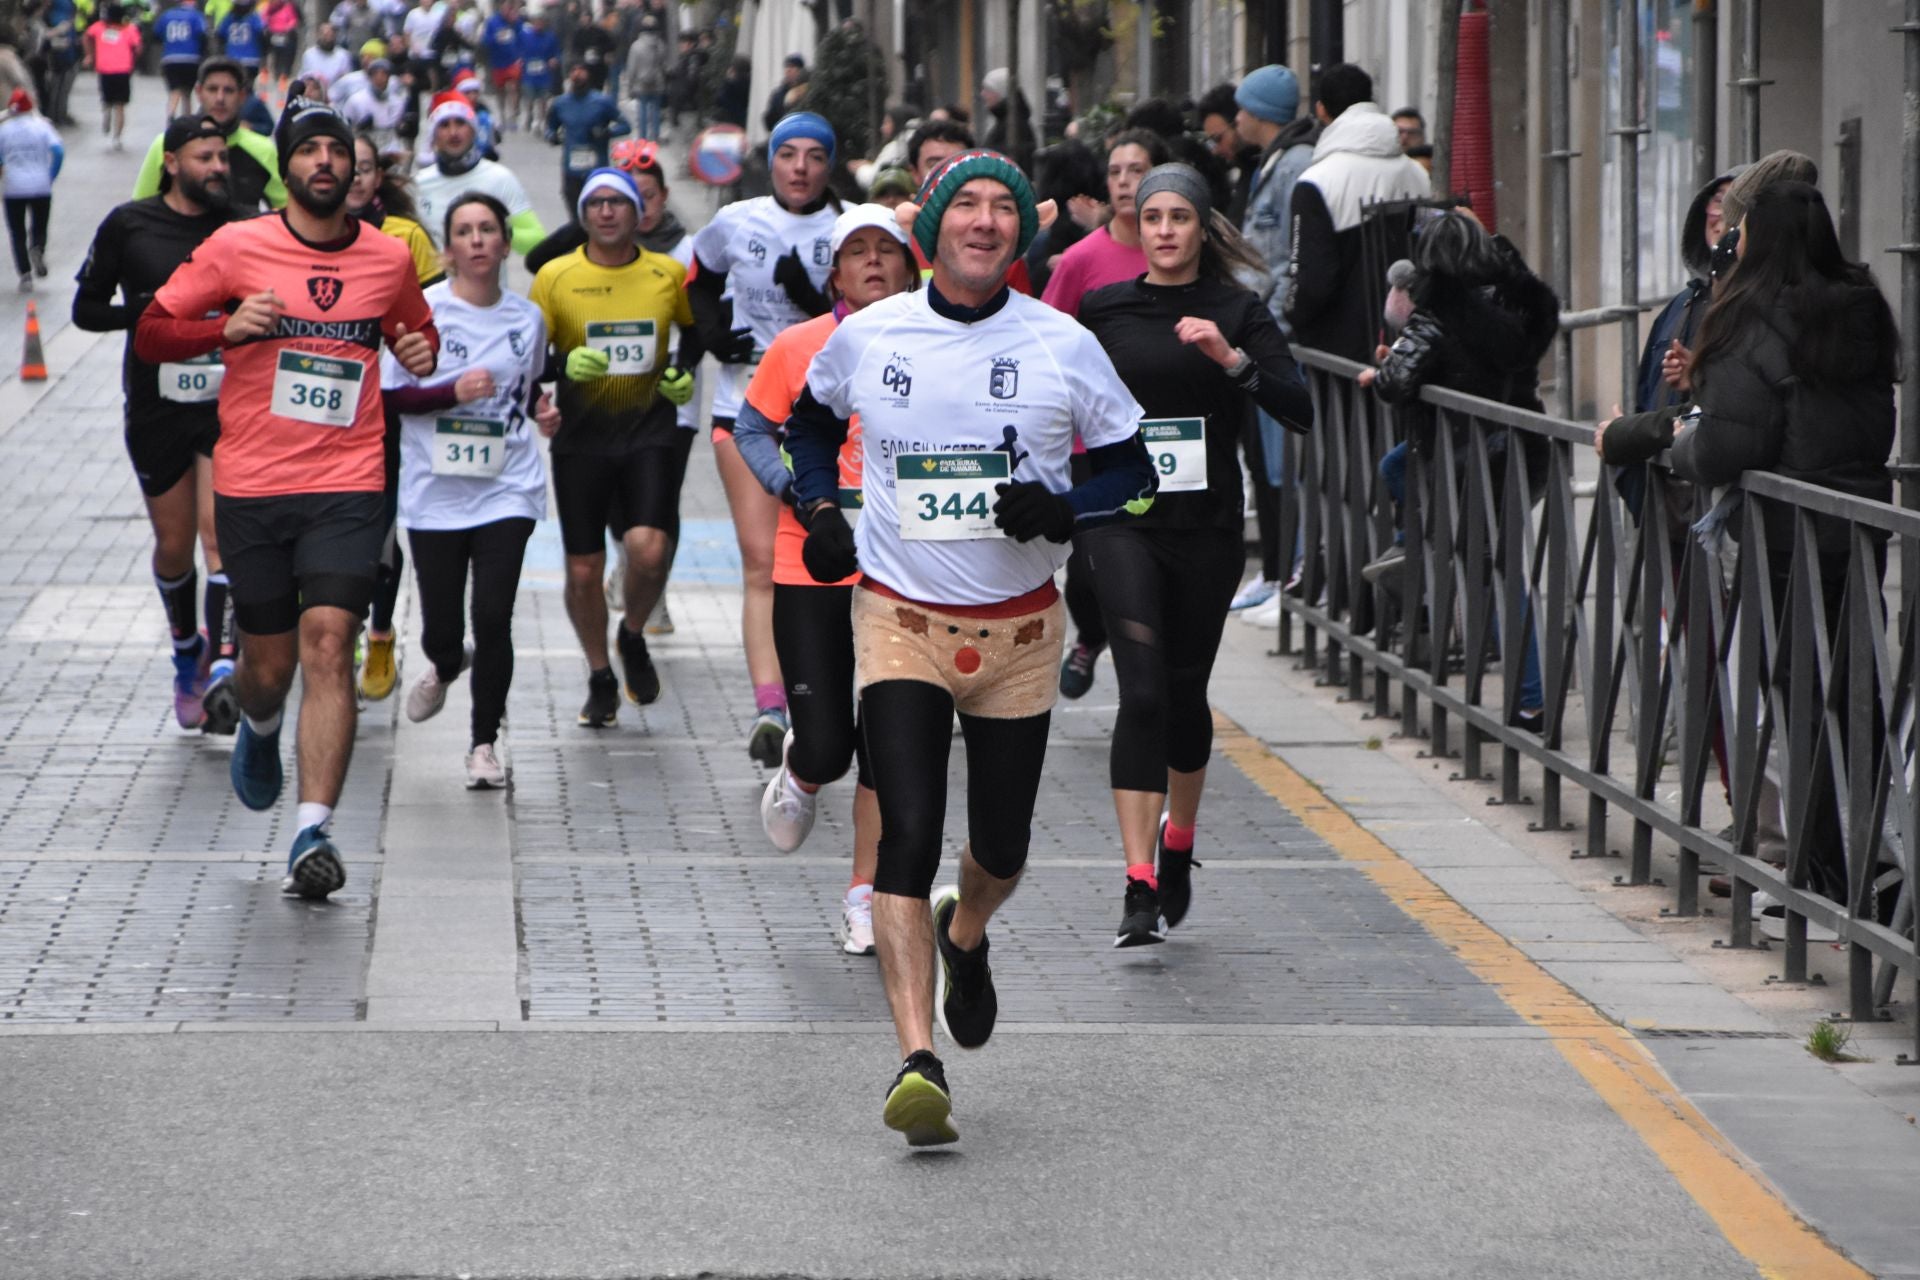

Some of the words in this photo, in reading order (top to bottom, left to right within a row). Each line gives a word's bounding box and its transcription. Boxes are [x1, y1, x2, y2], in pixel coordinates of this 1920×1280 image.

[601, 344, 643, 362] 193
[178, 373, 206, 390] 80
[883, 364, 911, 397] CPJ
[290, 383, 342, 410] 368
[446, 443, 490, 464] 311
[917, 491, 989, 521] 344
